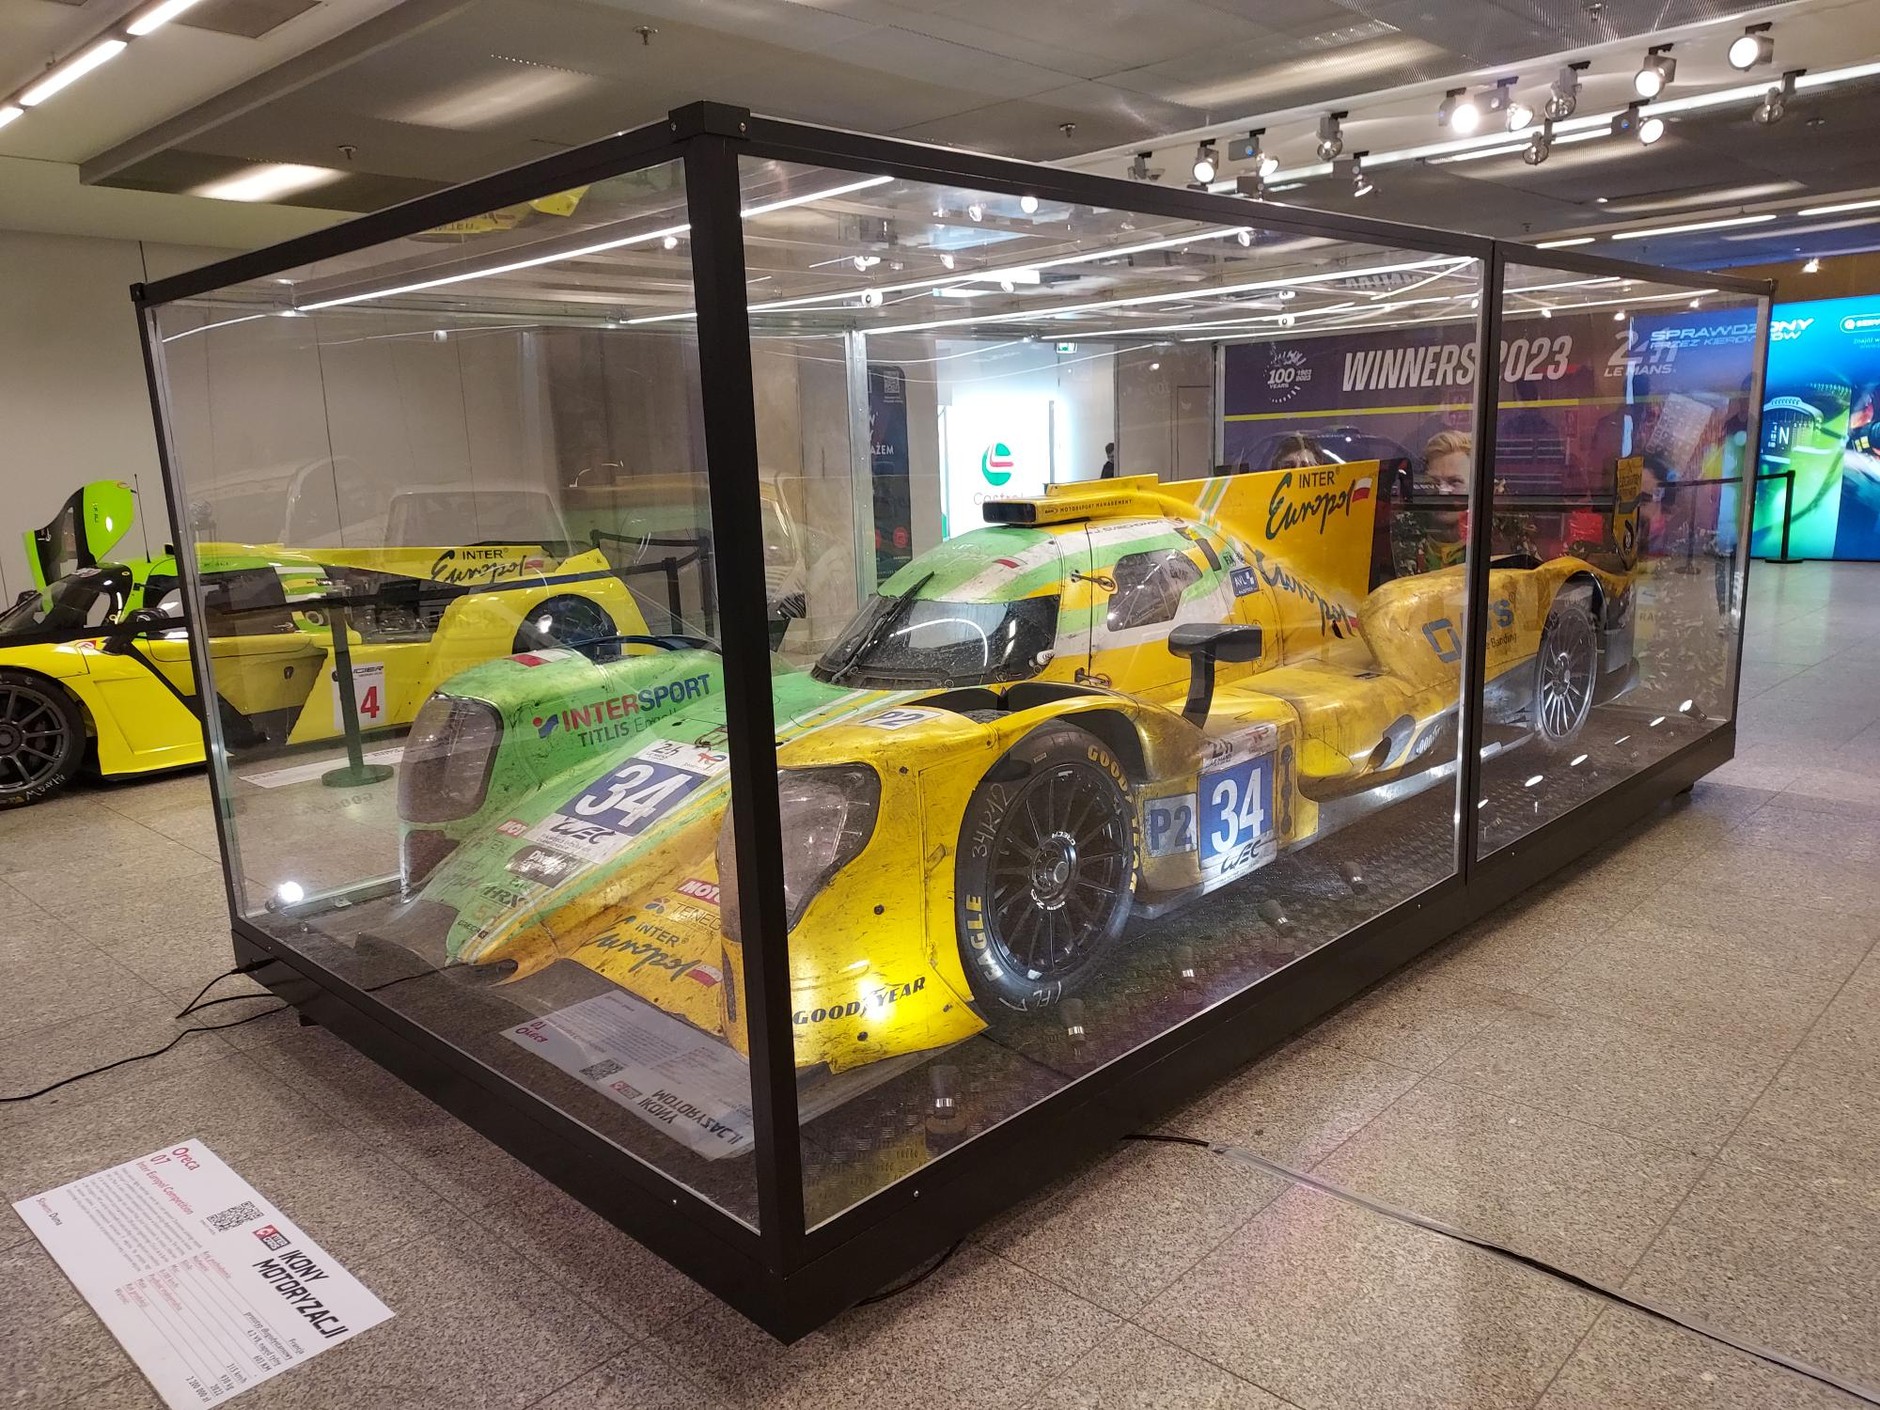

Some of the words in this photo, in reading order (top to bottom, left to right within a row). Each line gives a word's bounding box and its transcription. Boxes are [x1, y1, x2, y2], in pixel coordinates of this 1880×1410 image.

[1268, 367, 1296, 384] 100
[1343, 342, 1477, 392] WINNERS
[1604, 366, 1622, 378] LE
[1299, 471, 1335, 488] INTER
[1266, 472, 1356, 540] Europol
[463, 549, 503, 560] INTER
[361, 686, 380, 718] 4
[562, 673, 711, 733] INTERSPORT
[578, 721, 629, 747] TITLIS
[575, 764, 693, 828] 34
[1211, 767, 1265, 853] 34
[1150, 805, 1192, 851] P2
[636, 921, 680, 947] INTER
[966, 894, 1004, 982] EAGLE
[150, 1154, 171, 1166] 07
[172, 1147, 200, 1171] Oreca
[143, 1170, 169, 1189] Europol
[160, 1186, 197, 1215] Competition
[278, 1249, 329, 1283] IKONY
[252, 1258, 349, 1339] MOTORYZACJI
